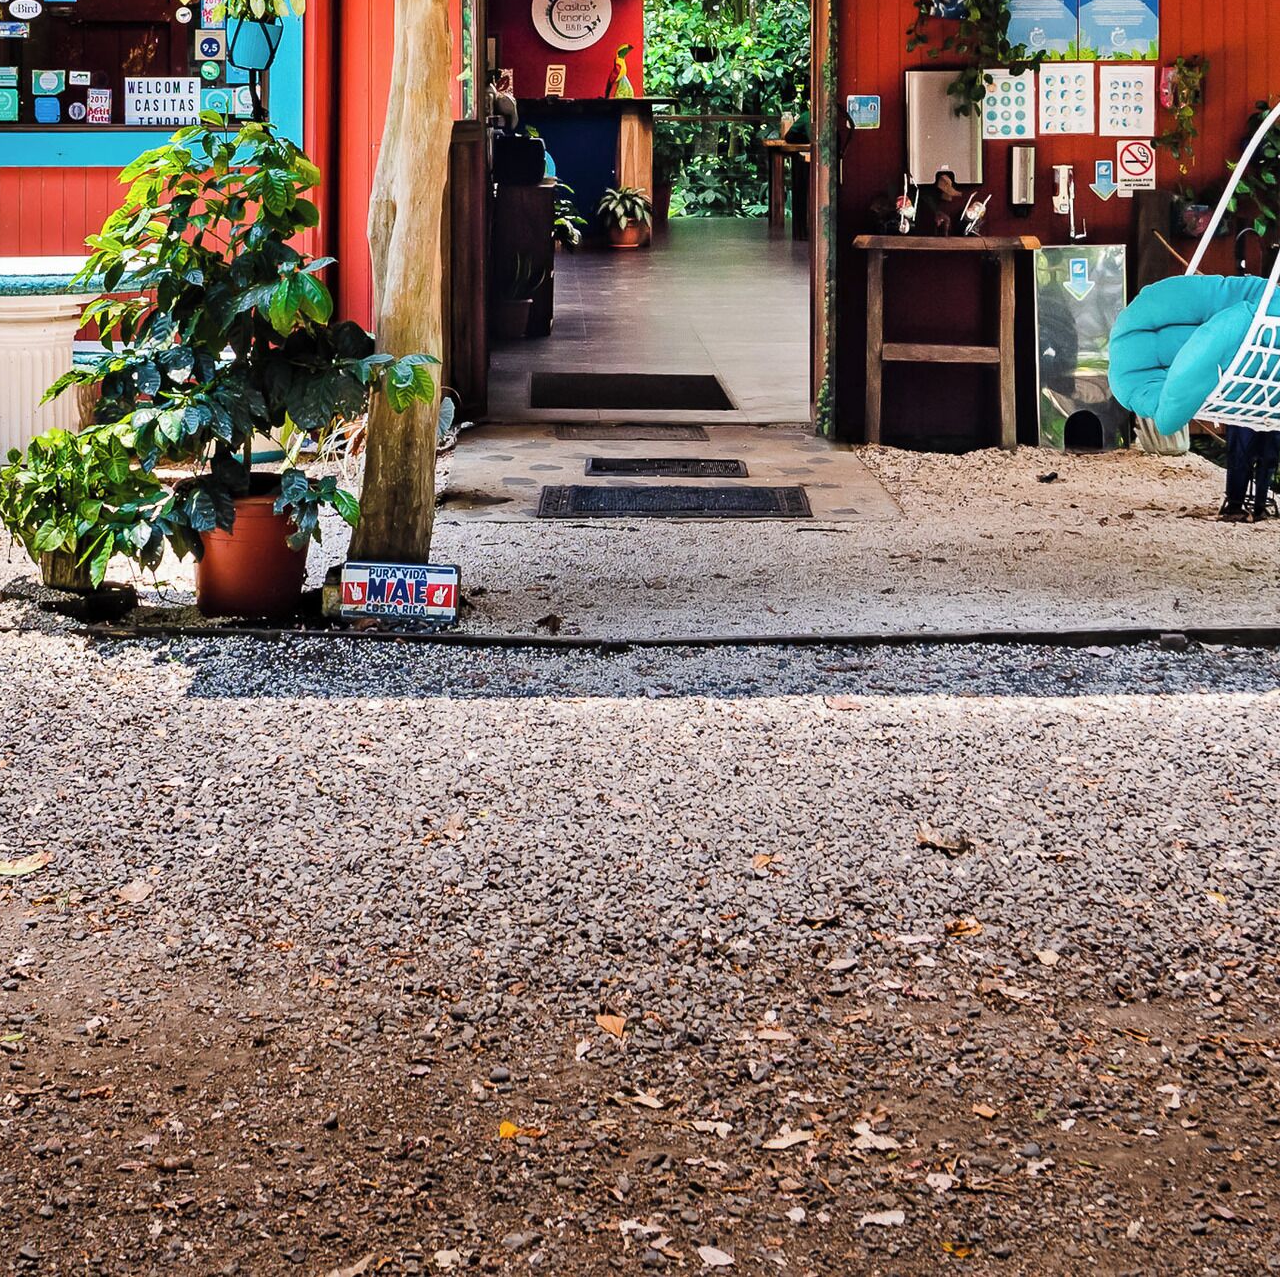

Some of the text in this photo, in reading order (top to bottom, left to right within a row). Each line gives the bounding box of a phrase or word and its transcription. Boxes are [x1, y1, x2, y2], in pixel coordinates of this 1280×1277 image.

[556, 1, 591, 12] Casitas
[556, 12, 591, 22] Tenorio
[202, 43, 218, 52] 9,5
[90, 95, 108, 103] 2017
[135, 99, 195, 112] CASITAS
[368, 568, 427, 580] PURA VIDA
[366, 577, 428, 604] MAE
[366, 603, 427, 616] COSTA RICA
